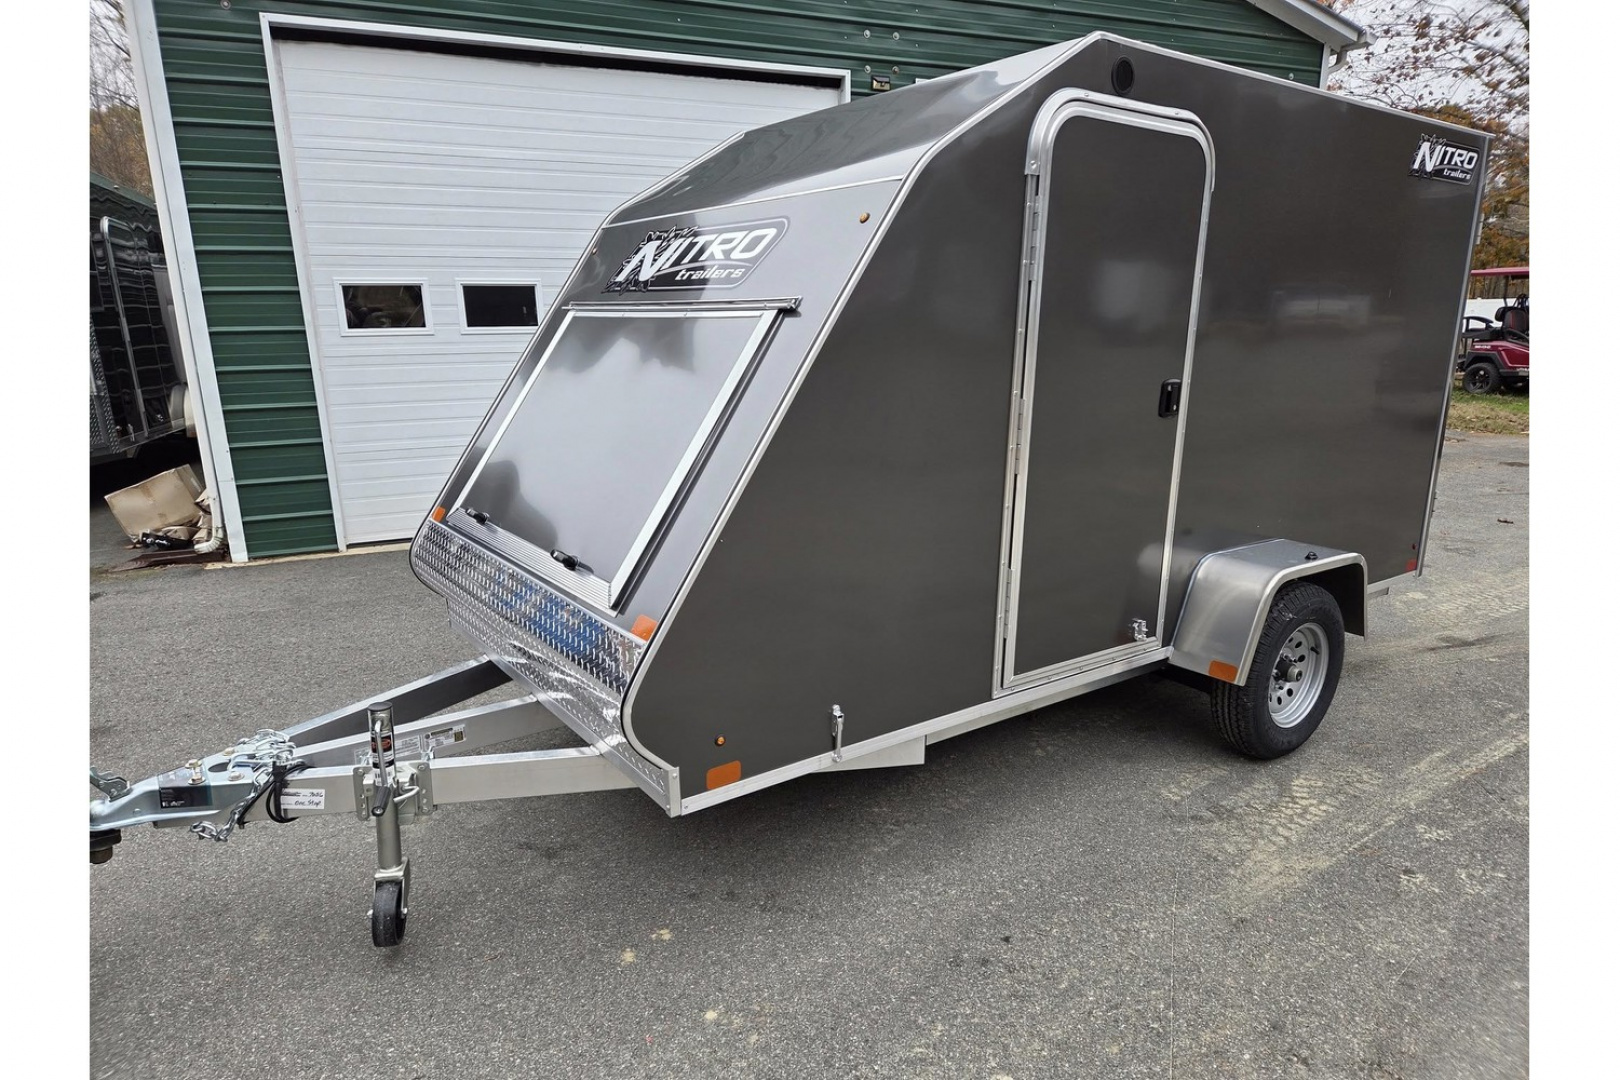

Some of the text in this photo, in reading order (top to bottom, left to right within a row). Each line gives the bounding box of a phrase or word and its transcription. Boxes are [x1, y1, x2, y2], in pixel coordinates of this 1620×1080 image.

[1412, 141, 1479, 173] NITRO
[1443, 168, 1472, 180] trailers
[614, 227, 778, 282] NITRO
[674, 265, 746, 281] trailers
